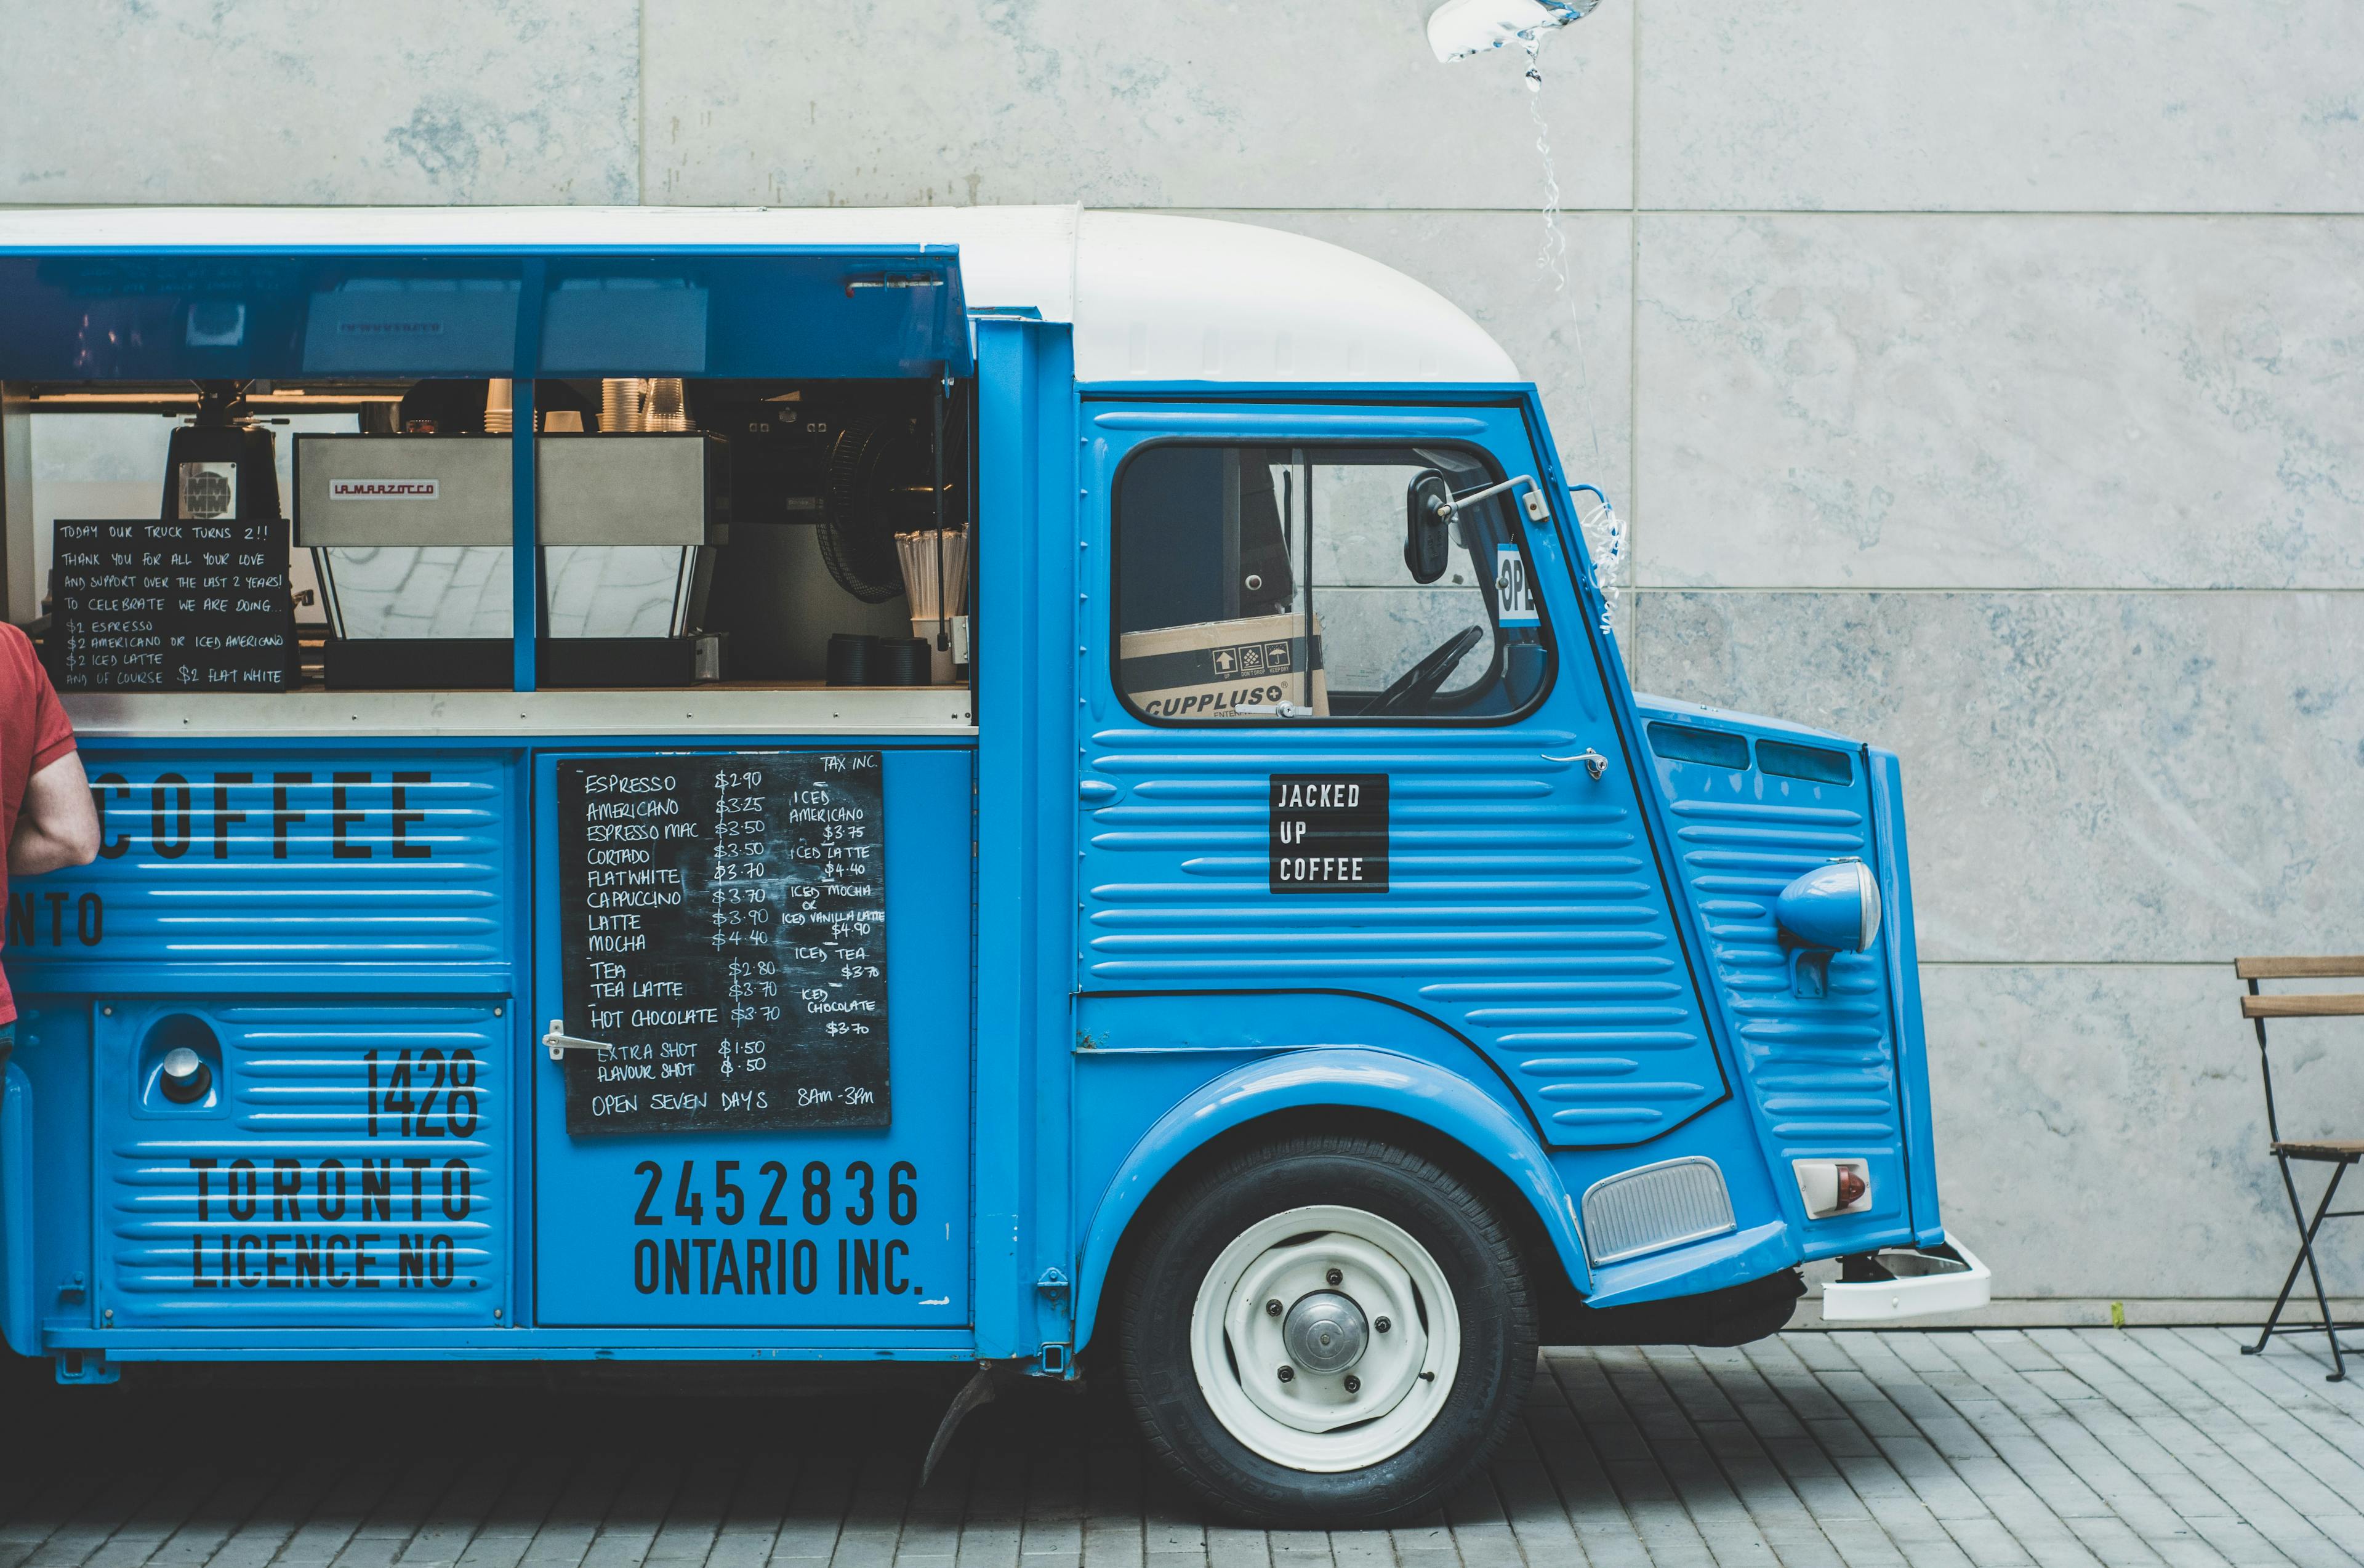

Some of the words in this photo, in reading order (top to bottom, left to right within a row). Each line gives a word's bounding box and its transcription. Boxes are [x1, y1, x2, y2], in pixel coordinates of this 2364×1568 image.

[60, 526, 98, 538] TODAY
[110, 527, 132, 537] OUR
[144, 526, 182, 538] TRUCK
[192, 527, 231, 539] TURNS
[62, 553, 100, 565] THANK
[111, 553, 132, 565] YOU
[142, 553, 161, 565] FOR
[171, 553, 191, 565] ALL
[203, 553, 228, 565] YOUR
[239, 553, 264, 565] LOVE
[65, 576, 86, 590] AND
[90, 576, 136, 589] SUPPORT
[144, 577, 169, 588] OVER
[176, 577, 196, 588] THE
[204, 576, 227, 588] LAST
[233, 576, 240, 587] 2
[246, 574, 282, 589] YEARS!
[65, 598, 78, 610] TO
[88, 598, 164, 611] CELEBRATE
[179, 599, 196, 611] WE
[204, 599, 227, 611] ARE
[66, 619, 84, 634] $2
[92, 621, 153, 632] ESPRESSO
[66, 637, 86, 652] $2
[91, 636, 161, 648] AMERICANO
[171, 636, 184, 646] OR
[195, 636, 220, 650] ICED
[66, 653, 86, 670] $2
[92, 654, 117, 666] ICED
[124, 653, 163, 665] LATTE
[66, 673, 87, 686] AND
[97, 673, 109, 684] OF
[117, 672, 163, 684] COURSE
[177, 665, 199, 683] $2
[208, 670, 236, 683] FLAT
[243, 670, 281, 683] WHITE
[820, 756, 846, 773] TAX
[585, 775, 675, 794] ESPRESSO
[715, 770, 762, 795] $2.90
[794, 790, 829, 805] ICED
[1279, 784, 1359, 807] JACKED
[92, 771, 431, 859] COFFEE
[586, 798, 678, 821] AMERICANO
[716, 795, 765, 818] $3.25
[790, 808, 863, 823] AMERICANO
[587, 824, 659, 842] ESPRESSO
[665, 823, 698, 838] MAC
[715, 818, 765, 838] $3.50
[823, 824, 865, 840] $3.75
[1280, 821, 1306, 844] UP
[587, 848, 649, 866] CORTADO
[714, 840, 764, 862] $3.50
[789, 846, 821, 859] ICED
[828, 846, 870, 859] LATTE
[714, 861, 764, 886] $3.70
[825, 861, 865, 877] $4.40
[1280, 858, 1362, 880] COFFEE
[712, 888, 766, 907] $3.70
[791, 886, 819, 898] ICED
[828, 885, 870, 896] MOCHA
[589, 914, 641, 931] LATTE
[712, 909, 768, 927] $3.90
[782, 913, 805, 925] ICED
[810, 911, 854, 923] VANILLA
[857, 911, 885, 922] LATTE
[589, 935, 646, 952] MOCHA
[712, 928, 768, 951] $4.40
[832, 923, 870, 939] $4.90
[795, 947, 827, 962] ICED
[835, 947, 870, 960] TEA
[590, 962, 625, 979] TEA
[729, 957, 776, 984] $2.80
[590, 981, 624, 998] TEA
[633, 981, 683, 997] LATTE
[729, 979, 777, 1002] $3.70
[802, 989, 828, 1002] ICED
[591, 1010, 624, 1029] HOT
[632, 1008, 718, 1027] CHOCOLATE
[731, 1002, 780, 1028] $3.70
[808, 1000, 875, 1013] CHOCOLATE
[826, 1021, 869, 1037] $3.70
[598, 1044, 653, 1062] EXTRA
[660, 1042, 698, 1058] SHOT
[597, 1064, 656, 1082] FLAVOUR
[661, 1063, 695, 1079] SHOT
[364, 1048, 478, 1138] 1428
[592, 1095, 637, 1116] OPEN
[650, 1093, 707, 1110] SEVEN
[722, 1090, 768, 1111] DAYS
[189, 1159, 470, 1221] TORONTO
[634, 1160, 917, 1226] 2452836
[193, 1234, 380, 1289] LICENCE
[399, 1234, 477, 1289] NO.
[634, 1239, 818, 1295] ONTARIO
[838, 1239, 923, 1295] INC.
